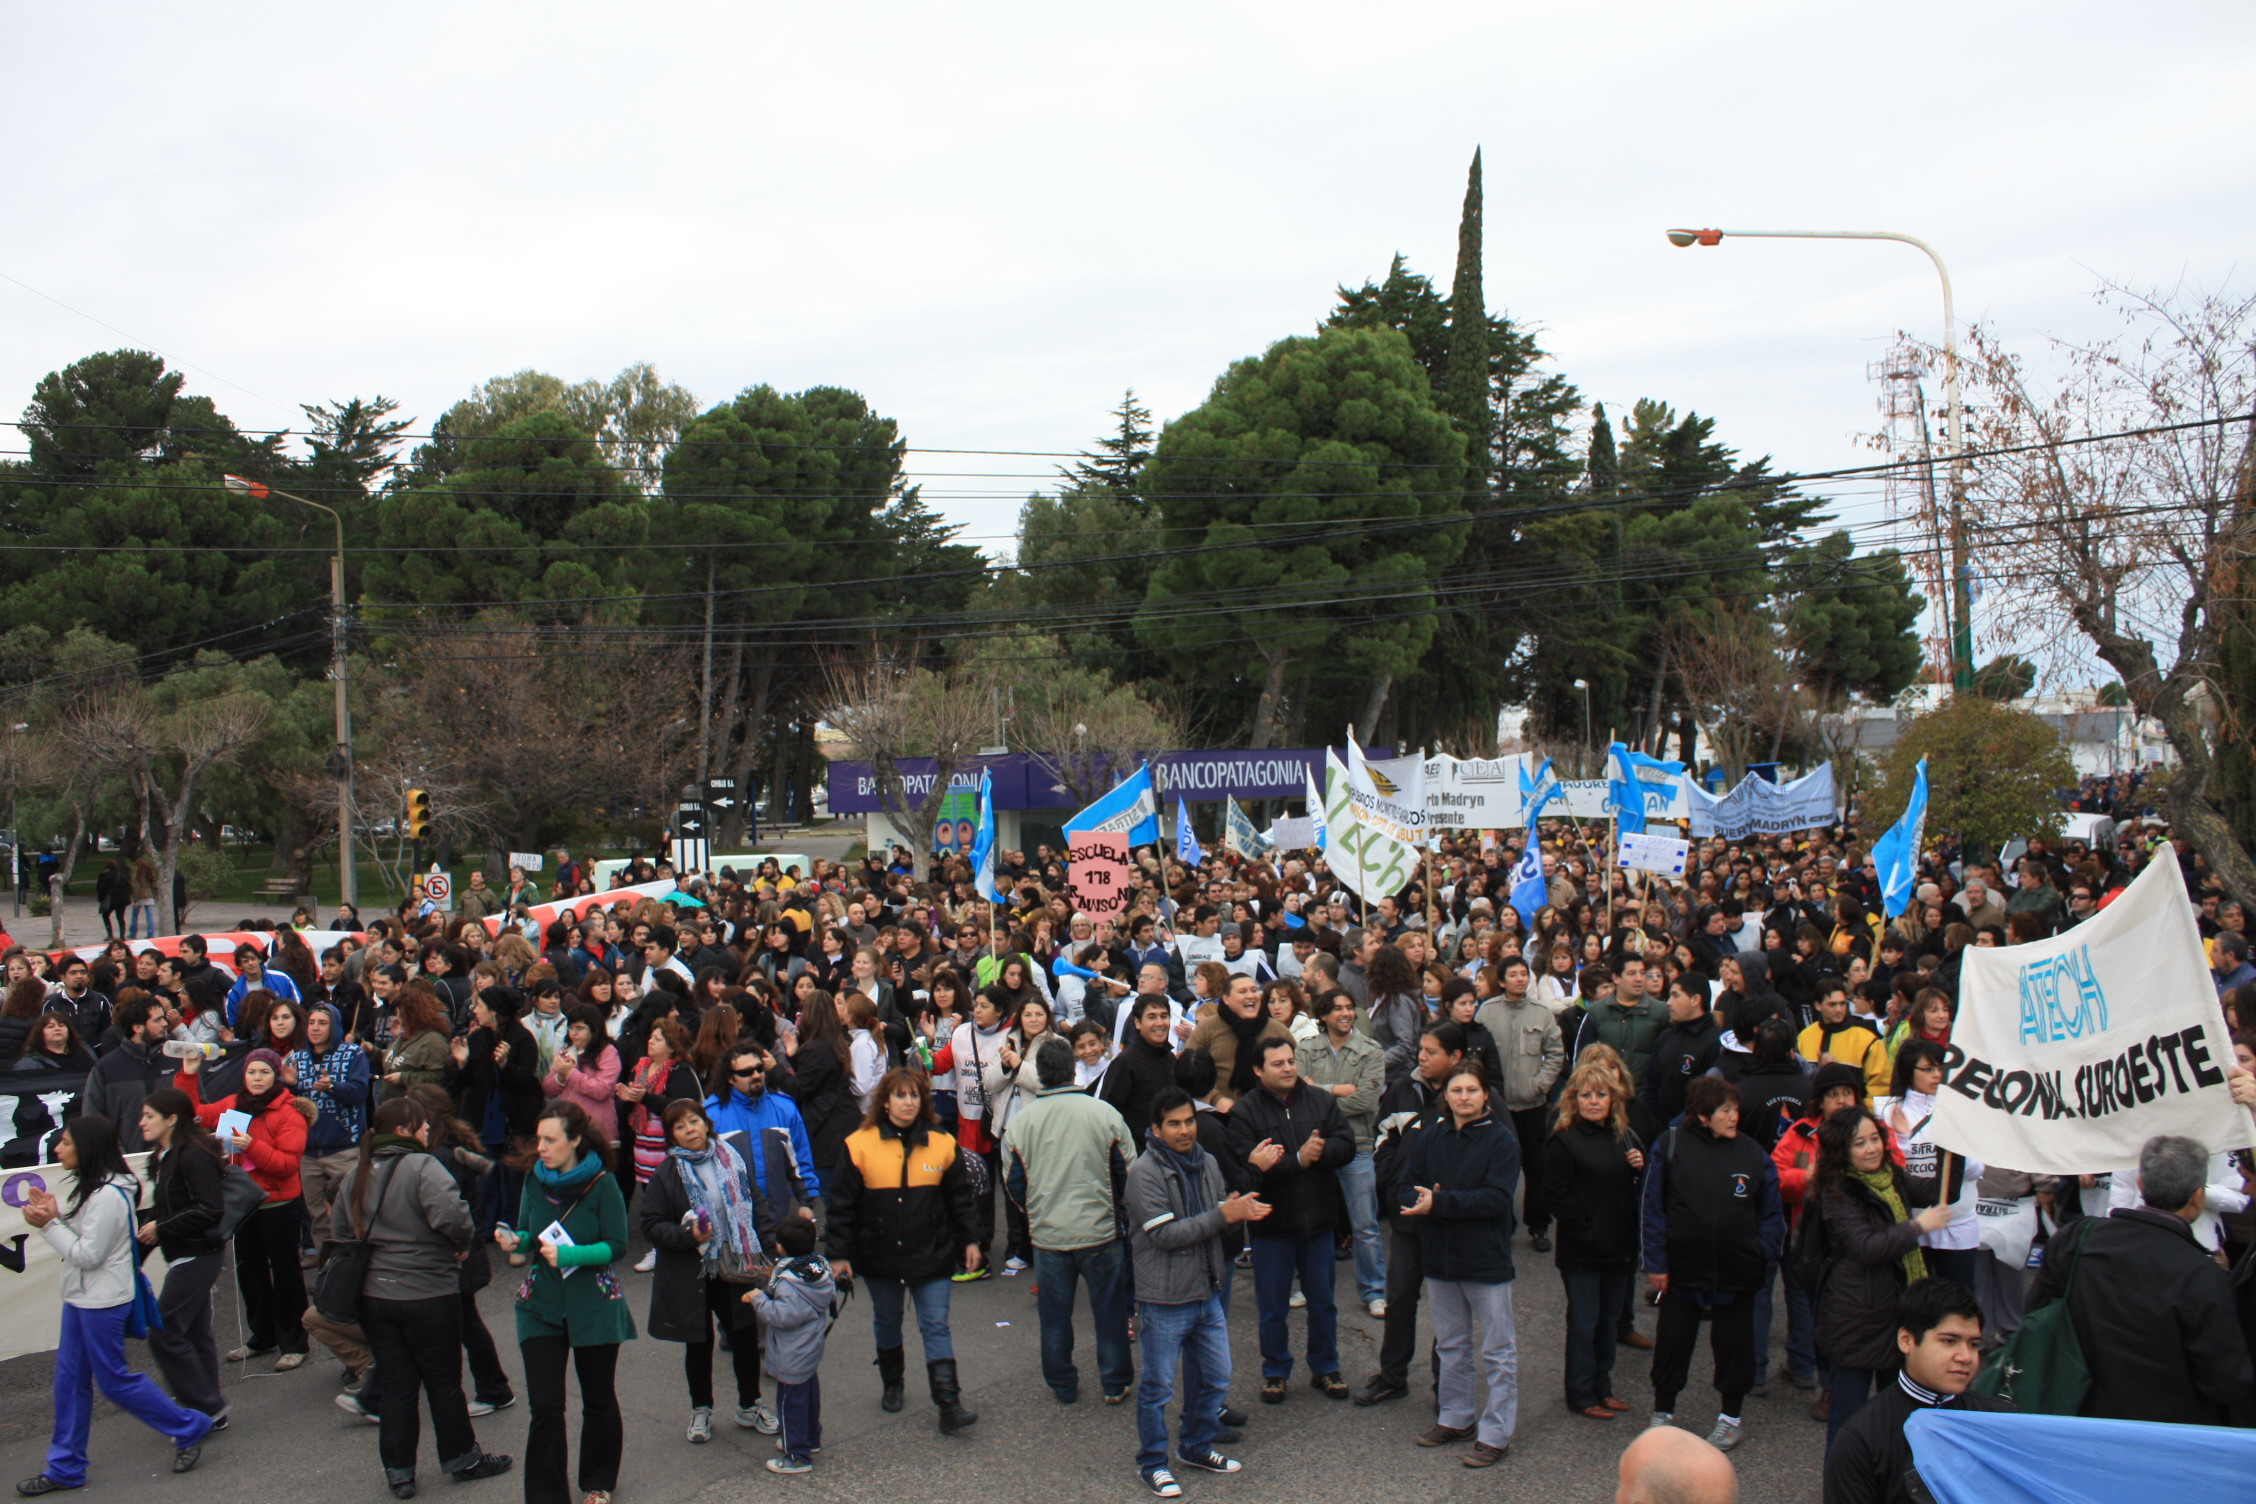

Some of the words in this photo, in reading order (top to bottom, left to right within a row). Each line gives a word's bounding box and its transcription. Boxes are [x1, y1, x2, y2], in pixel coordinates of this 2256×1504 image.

[1157, 759, 1305, 790] BANCOPATAGONIA
[1441, 793, 1485, 809] Madryn
[1751, 815, 1807, 831] MADRYN
[1069, 844, 1128, 865] ESCUELA
[1085, 871, 1111, 885] 178
[1069, 885, 1129, 912] RAWSON
[2019, 944, 2108, 1046] ATECH
[2074, 1024, 2225, 1119] SUROESTE
